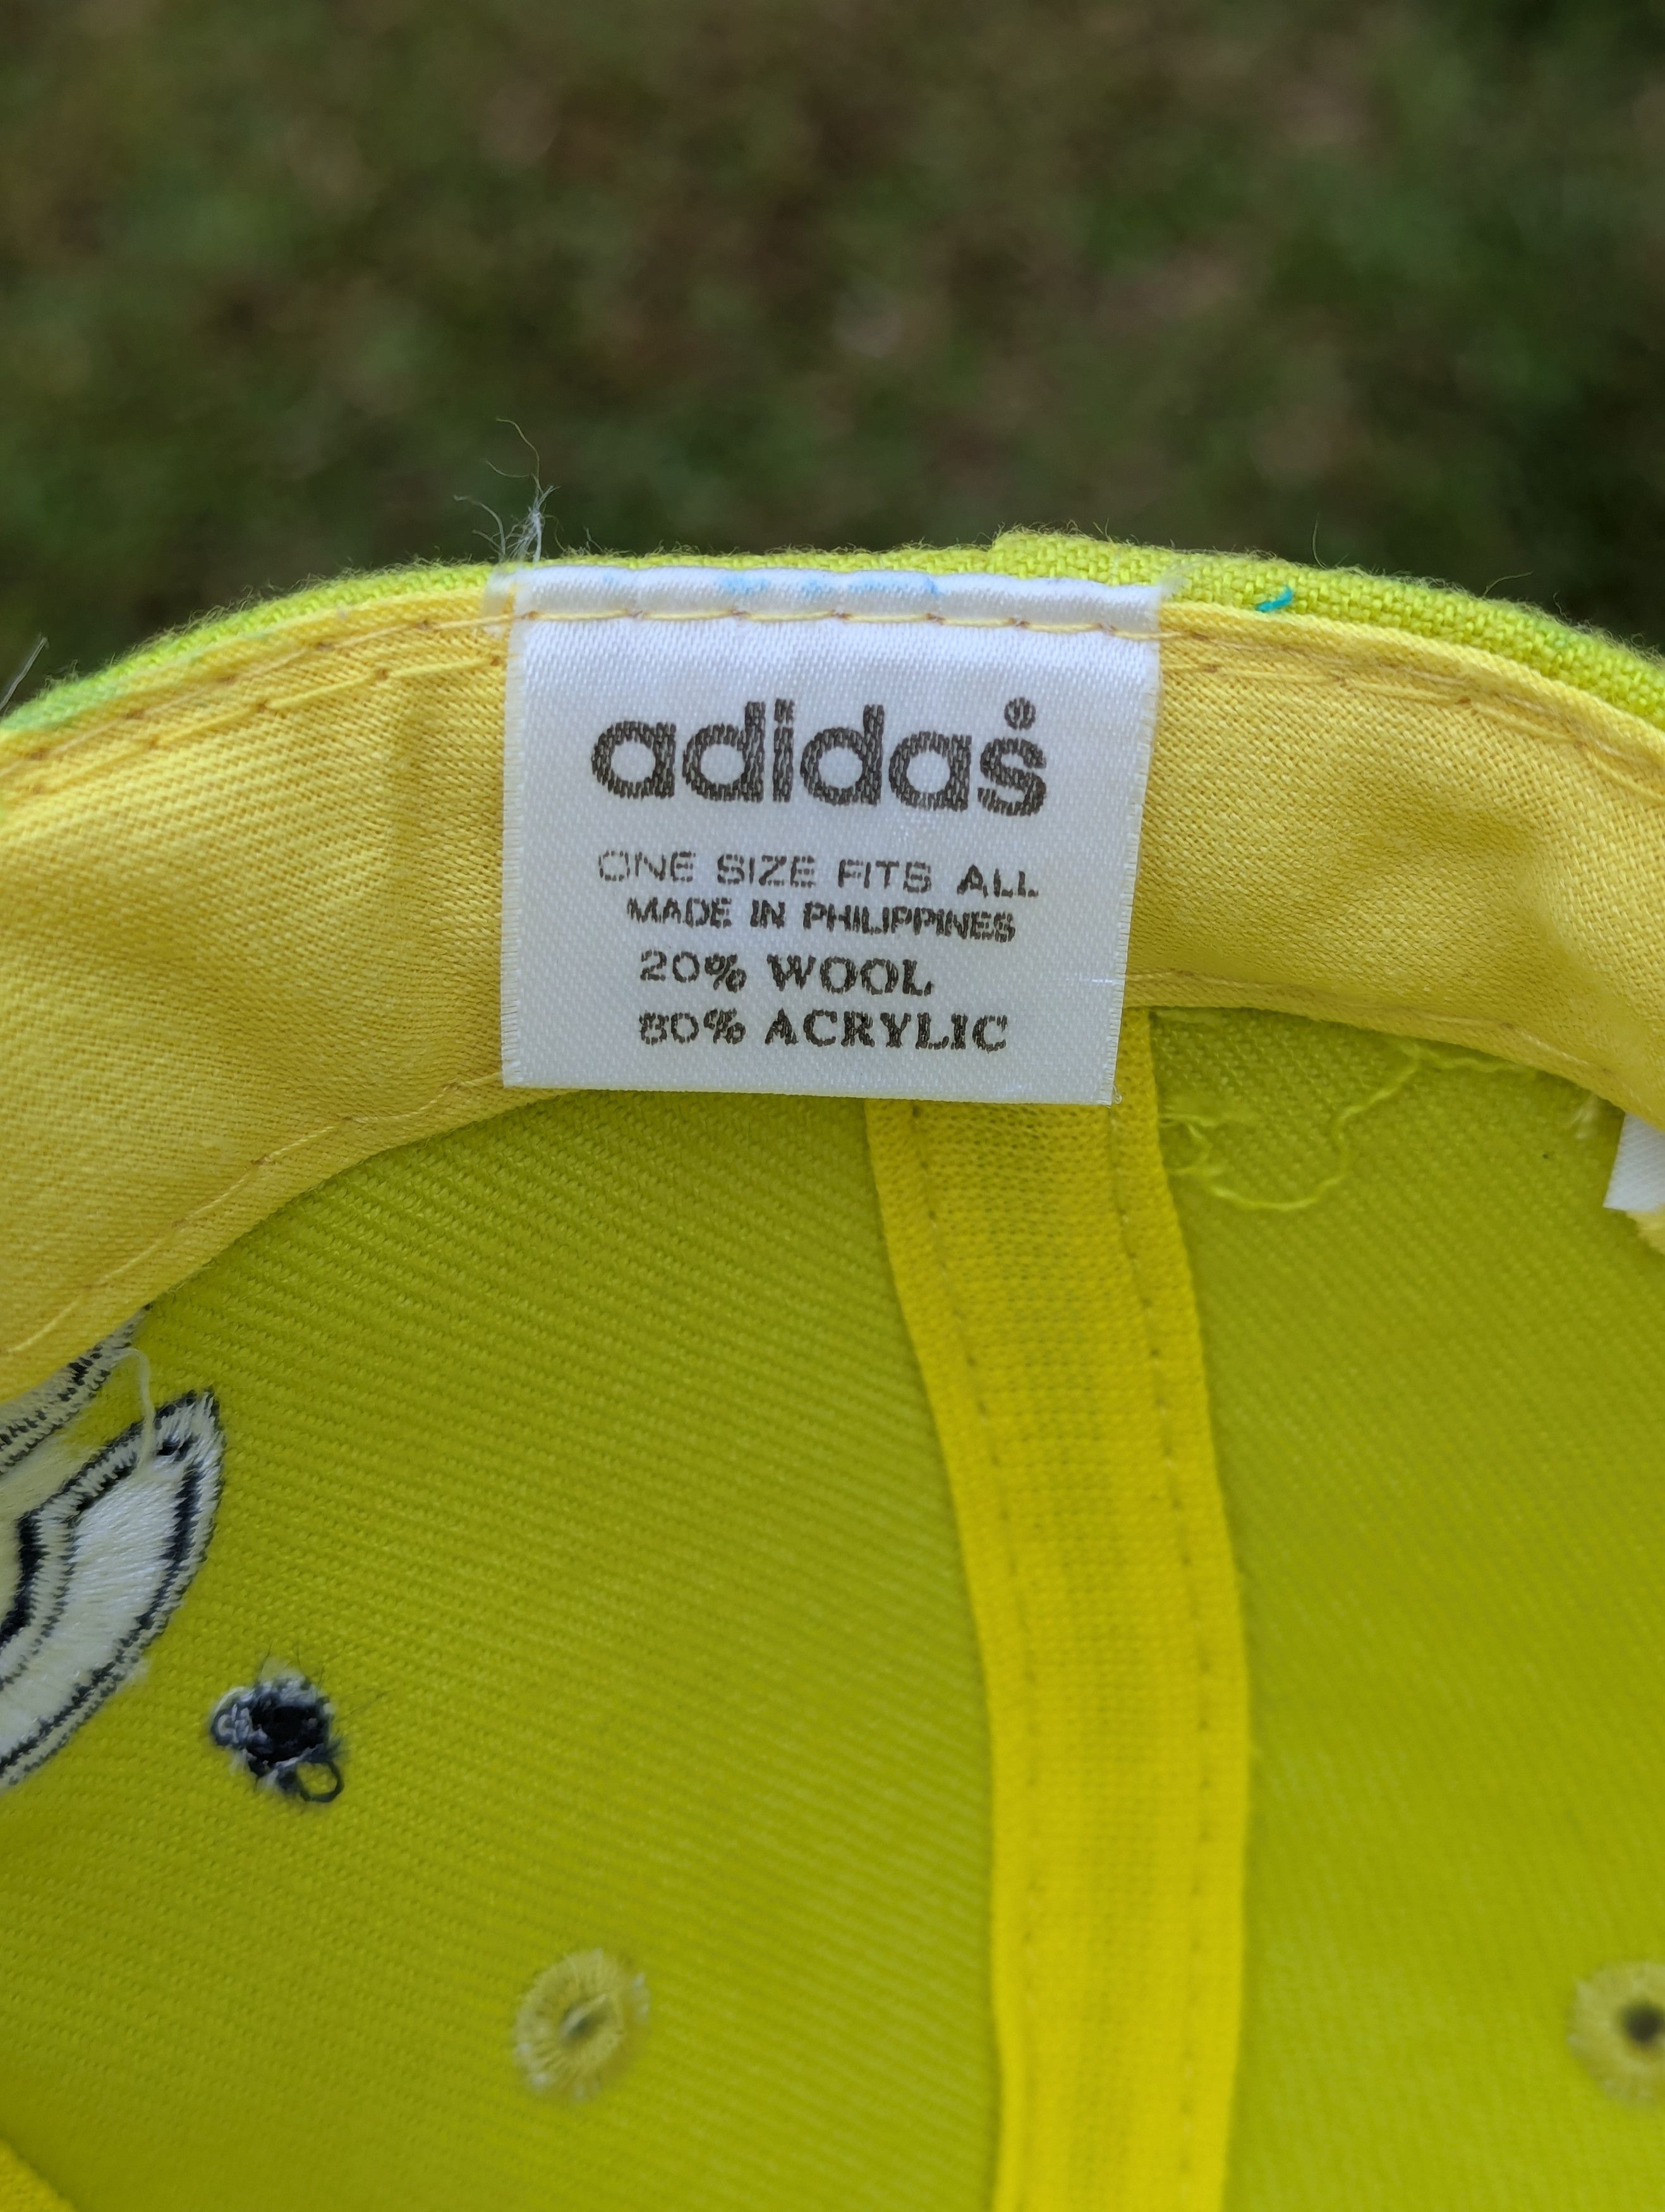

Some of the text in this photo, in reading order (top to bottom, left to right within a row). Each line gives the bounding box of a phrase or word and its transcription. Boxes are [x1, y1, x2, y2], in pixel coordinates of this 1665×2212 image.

[597, 850, 1039, 898] ONE SIZE FITS ALL
[627, 897, 1016, 942] MADE IN PHILIPPINES
[639, 951, 934, 995] 20% WOOL
[639, 1009, 1008, 1054] 80% ACRYLIC
